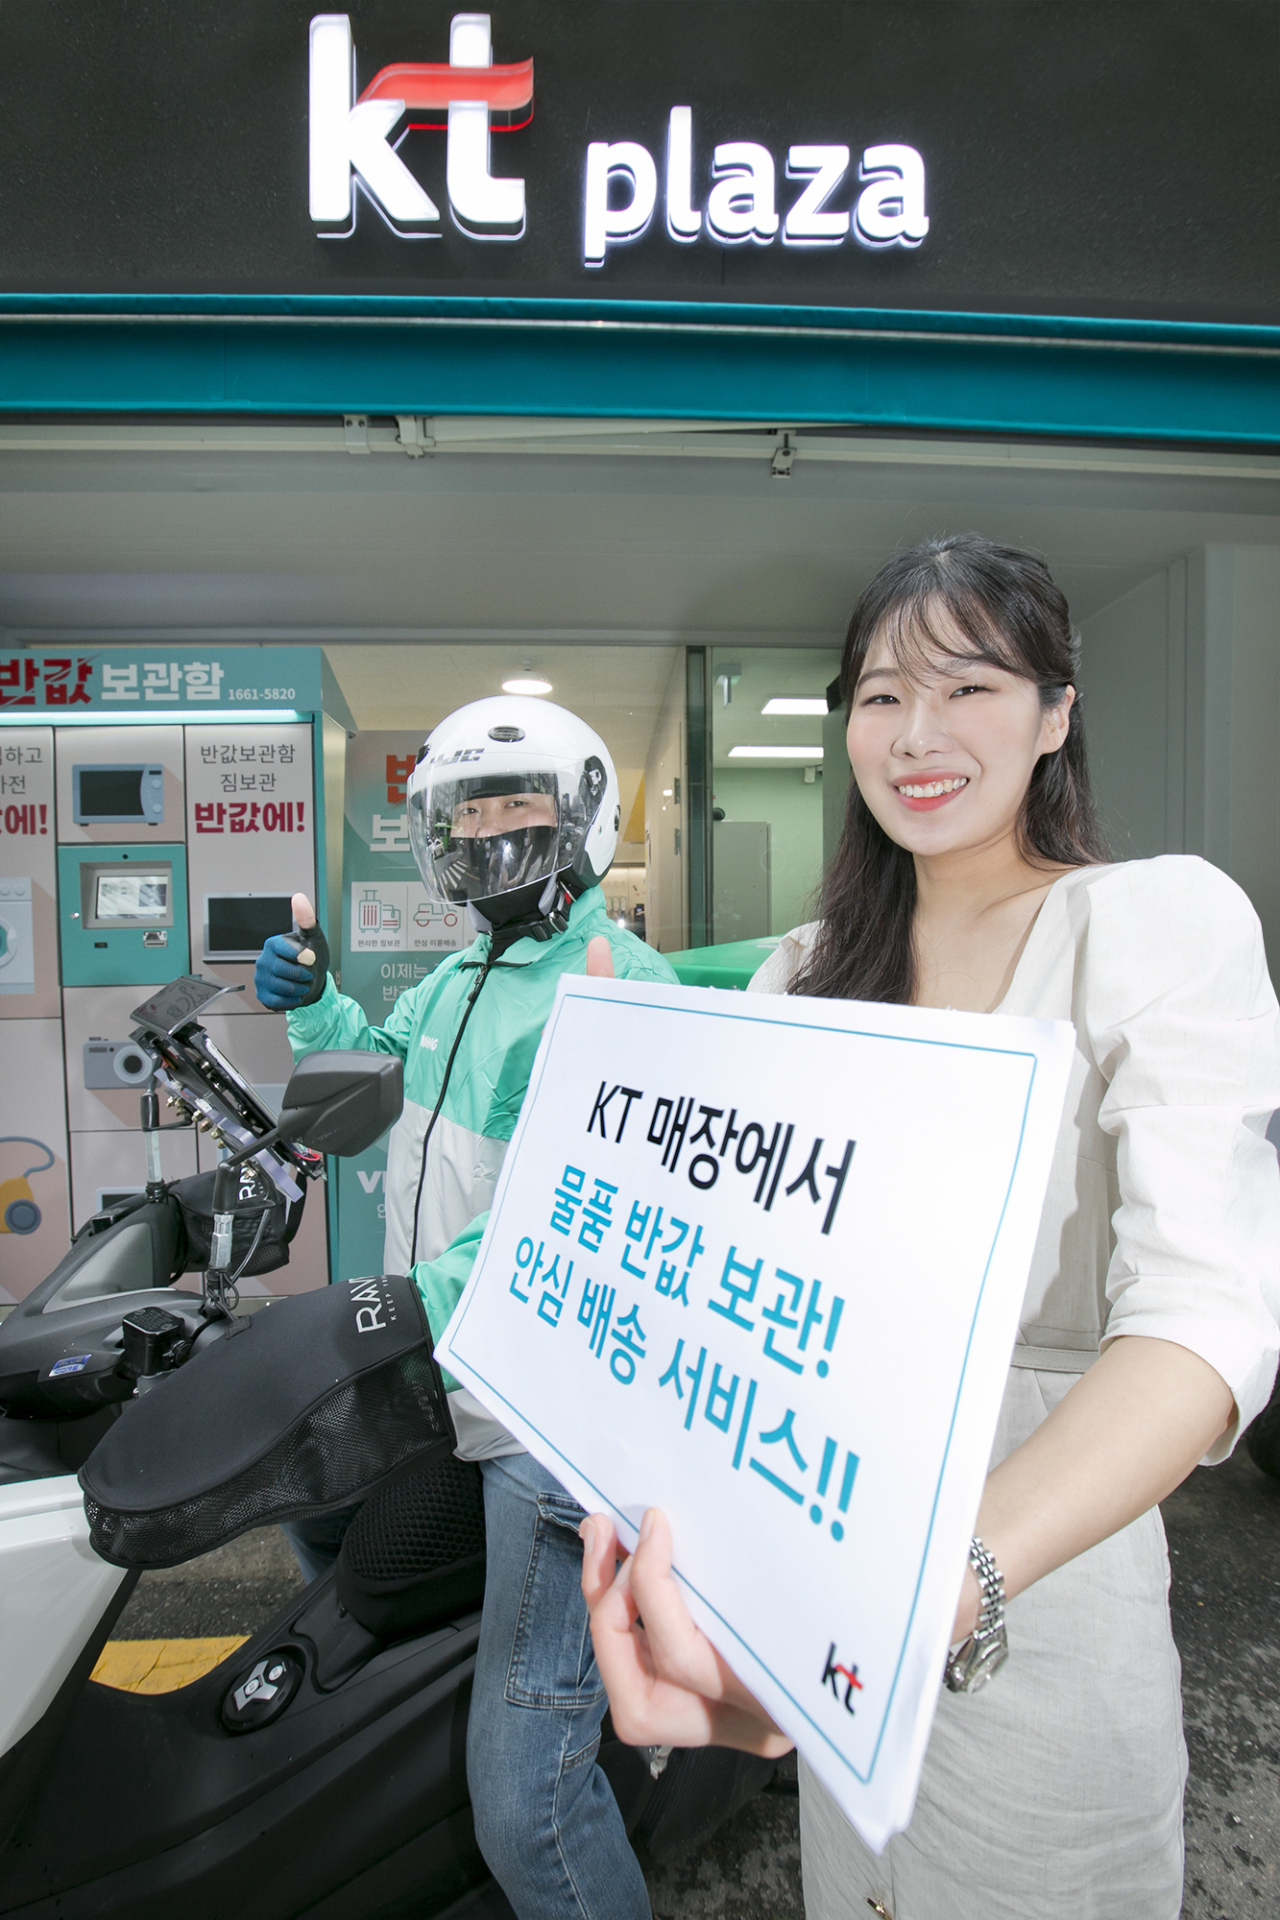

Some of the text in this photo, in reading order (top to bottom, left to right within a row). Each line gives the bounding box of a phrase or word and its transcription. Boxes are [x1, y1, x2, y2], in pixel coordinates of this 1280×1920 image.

[308, 13, 930, 268] kt plaza
[0, 657, 296, 706] 반값 보관함 1661-5820
[0, 746, 43, 766] 하고
[200, 744, 296, 765] 반값보관함
[220, 773, 278, 793] 짐보관
[0, 804, 48, 836] 에!
[194, 802, 306, 834] 반값에!
[381, 963, 428, 979] 이제는
[587, 1081, 857, 1236] KT 매장에서
[550, 1164, 845, 1379] 물품 반값 보관!
[385, 1293, 397, 1321] KEEP
[509, 1236, 860, 1542] 안심 배송 서비스!!
[821, 1640, 864, 1716] kt
